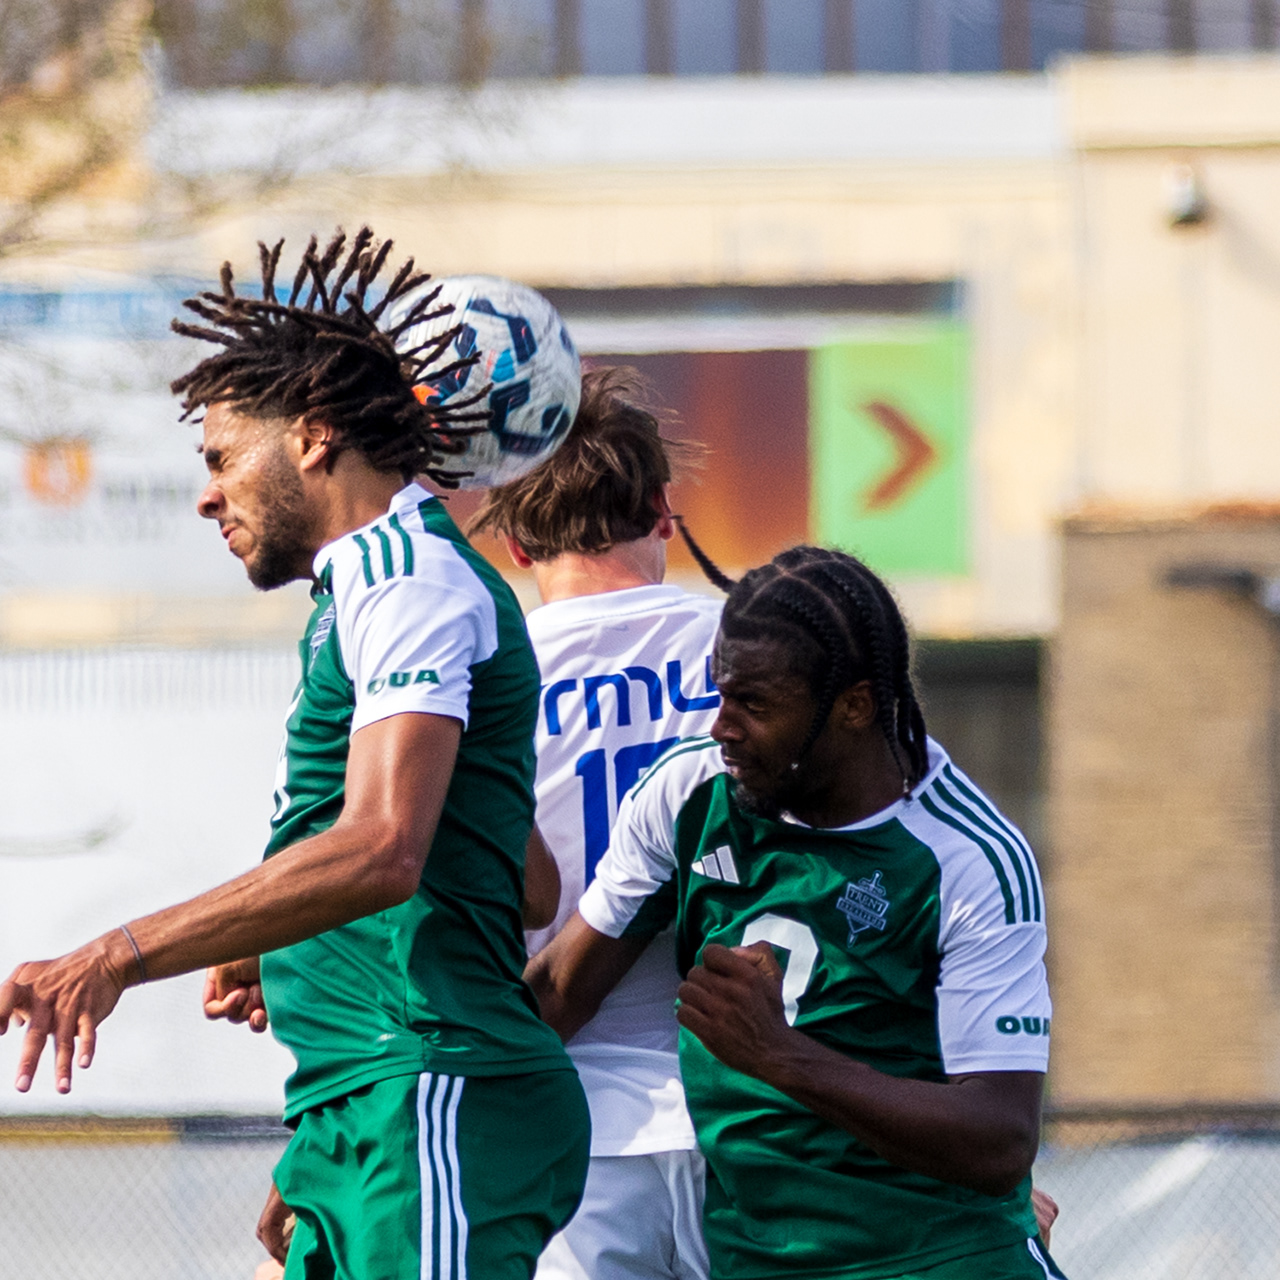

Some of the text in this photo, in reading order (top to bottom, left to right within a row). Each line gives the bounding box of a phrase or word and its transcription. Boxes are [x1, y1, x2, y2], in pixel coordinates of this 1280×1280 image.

[367, 669, 442, 696] OUA
[575, 736, 681, 894] 1
[850, 889, 884, 912] TRENT
